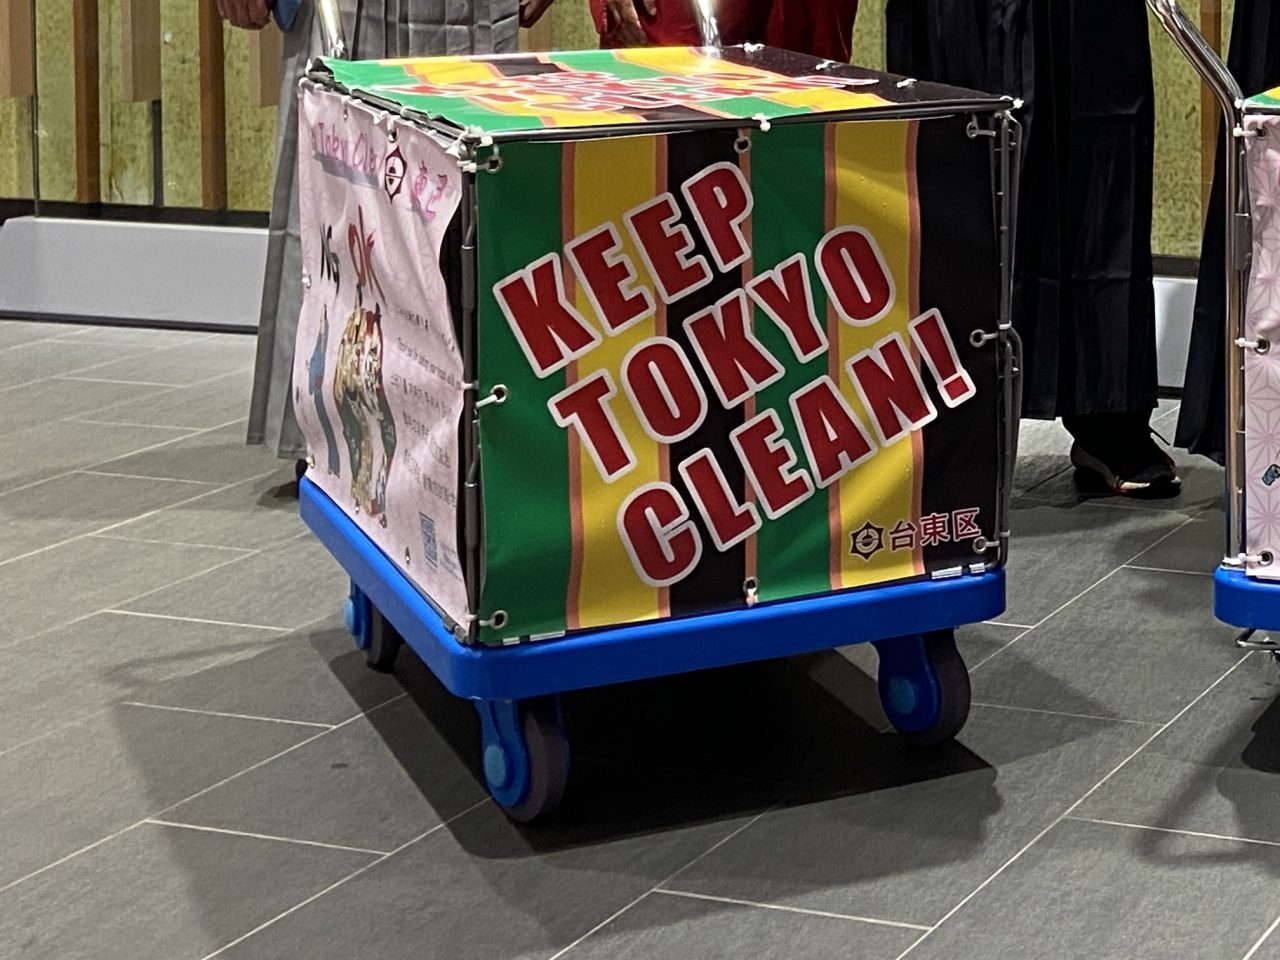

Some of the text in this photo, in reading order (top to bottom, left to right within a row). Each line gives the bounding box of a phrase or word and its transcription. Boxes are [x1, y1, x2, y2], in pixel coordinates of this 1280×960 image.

[493, 161, 754, 379] KEEP
[547, 224, 896, 484] TOKYO
[616, 308, 977, 587] CLEAN!
[889, 507, 982, 552] 台東区
